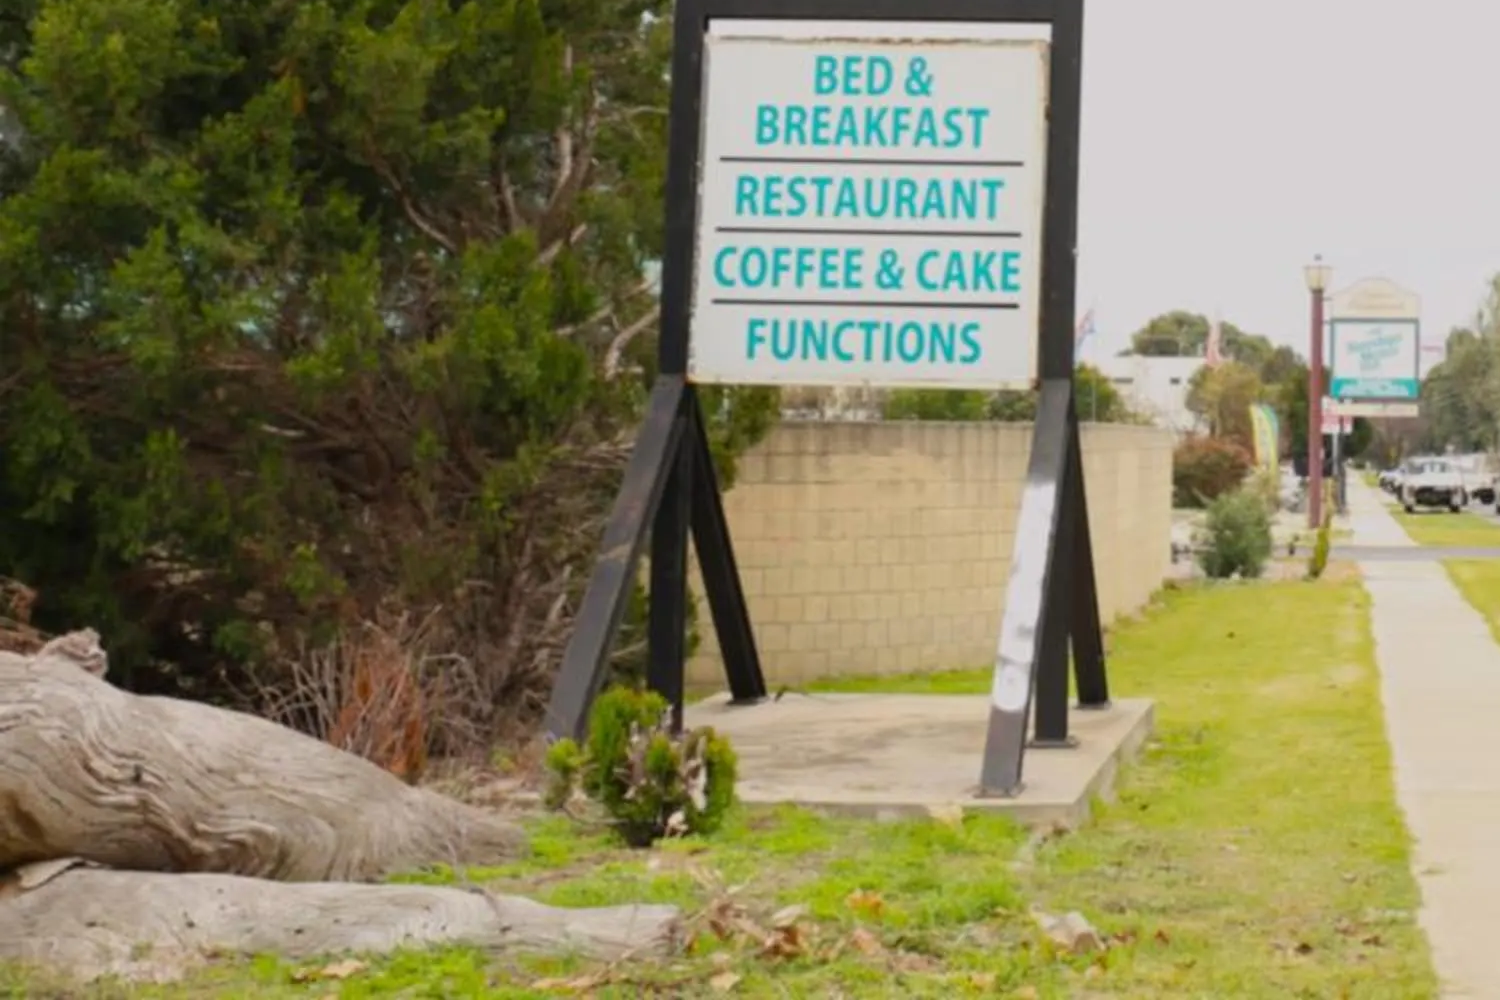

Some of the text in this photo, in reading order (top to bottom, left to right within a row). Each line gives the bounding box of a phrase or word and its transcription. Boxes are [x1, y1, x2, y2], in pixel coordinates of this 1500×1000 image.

[813, 55, 935, 97] BED &
[755, 104, 990, 148] BREAKFAST
[735, 175, 1005, 220] RESTAURANT
[713, 246, 1022, 292] COFFEE & CAKE
[745, 318, 982, 364] FUNCTIONS
